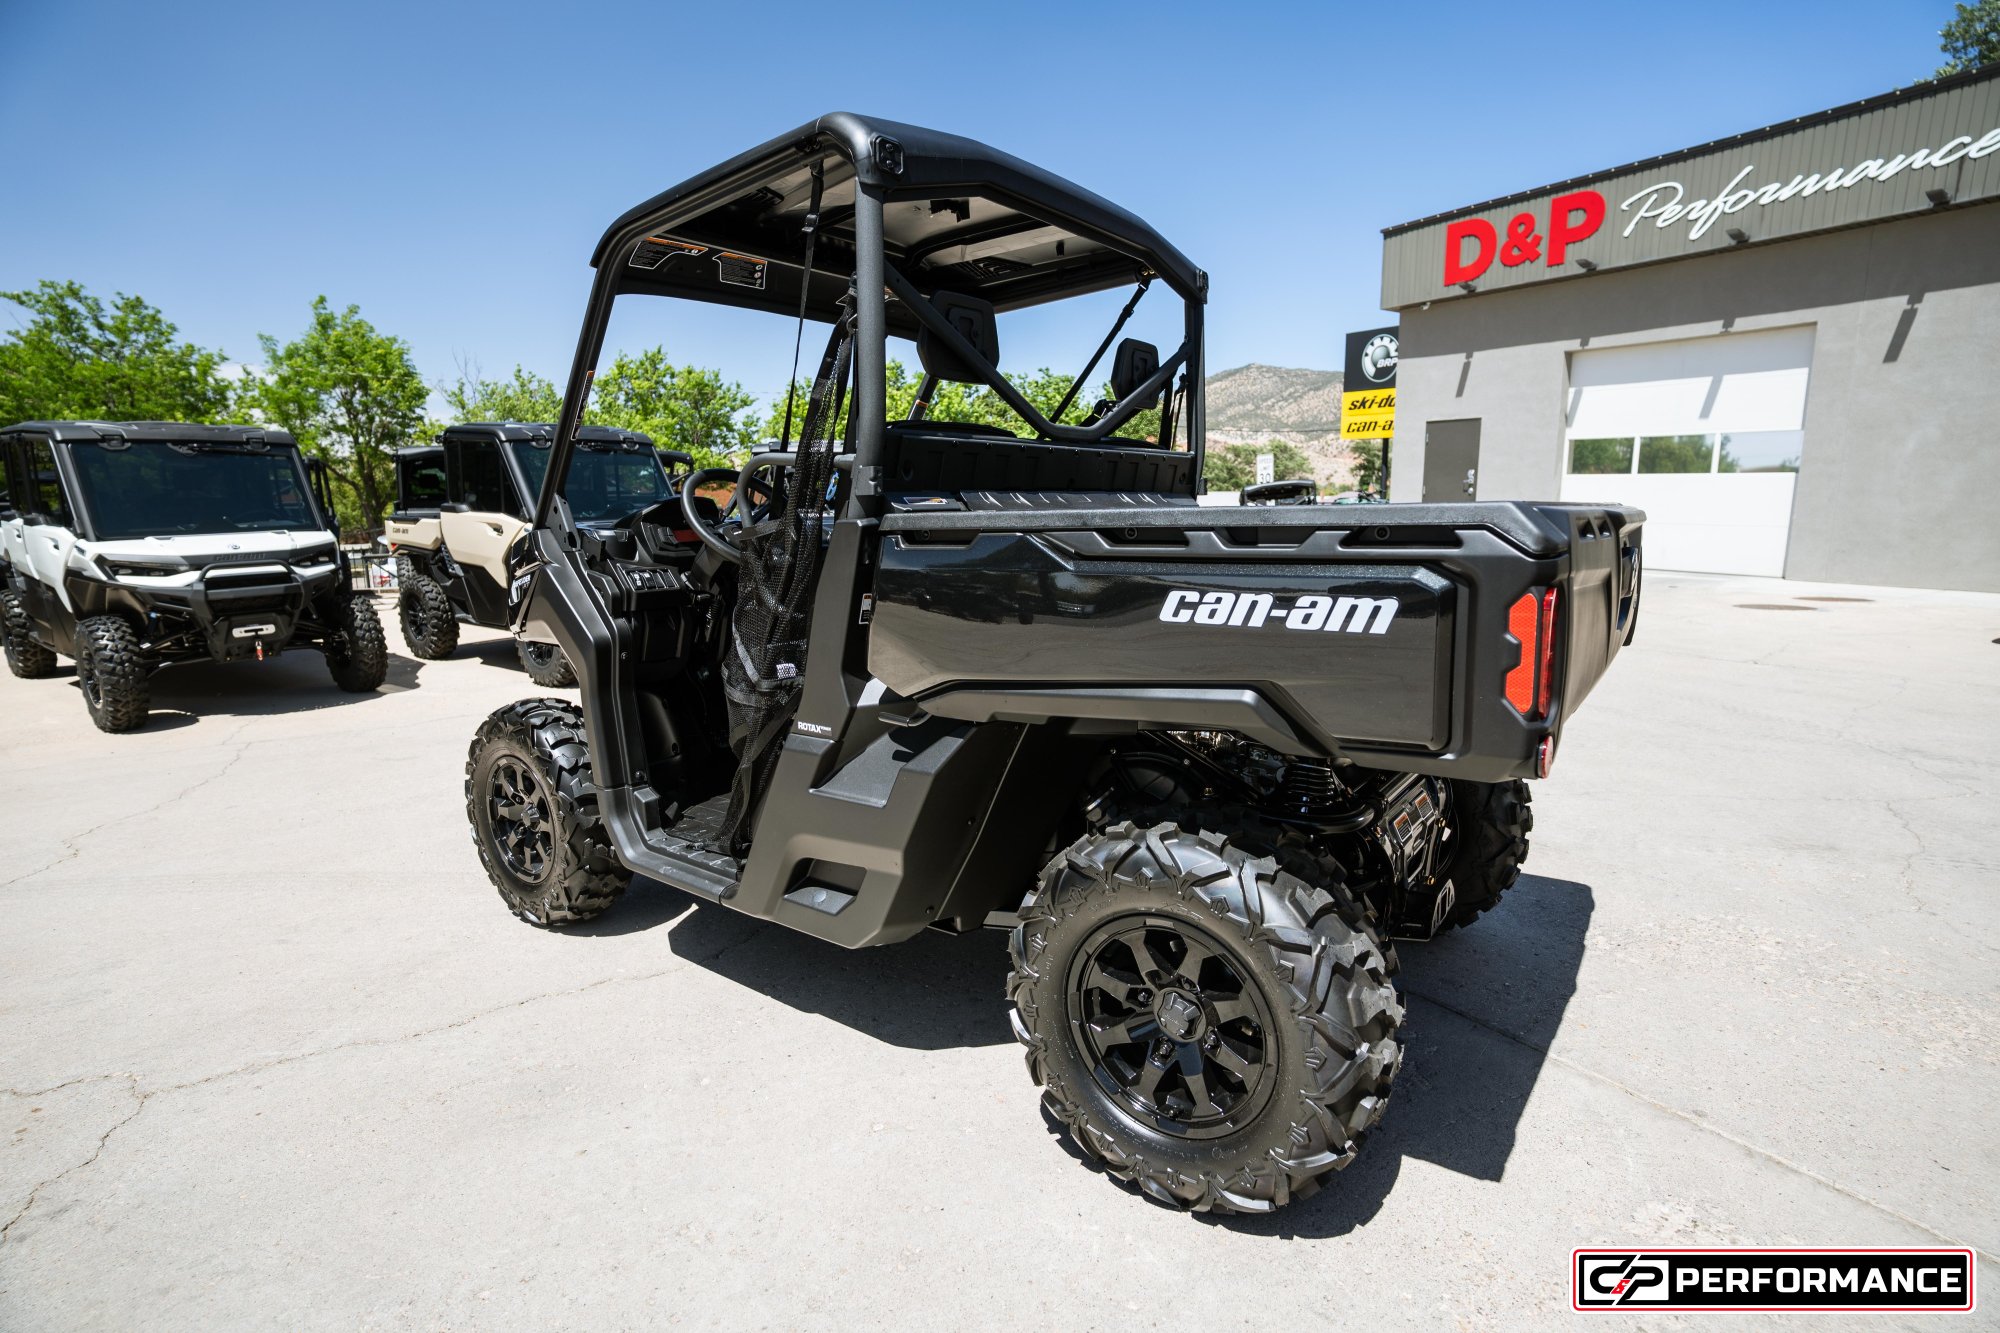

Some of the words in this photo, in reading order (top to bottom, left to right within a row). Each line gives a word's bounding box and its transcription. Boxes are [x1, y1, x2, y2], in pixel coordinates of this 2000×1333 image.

[1443, 190, 1607, 287] D&P
[1620, 127, 2000, 241] Performance
[1376, 357, 1399, 369] BRP
[1348, 394, 1396, 411] ski-do
[1346, 419, 1394, 433] can-a
[1158, 589, 1400, 635] can-am
[797, 720, 822, 734] ROTAX
